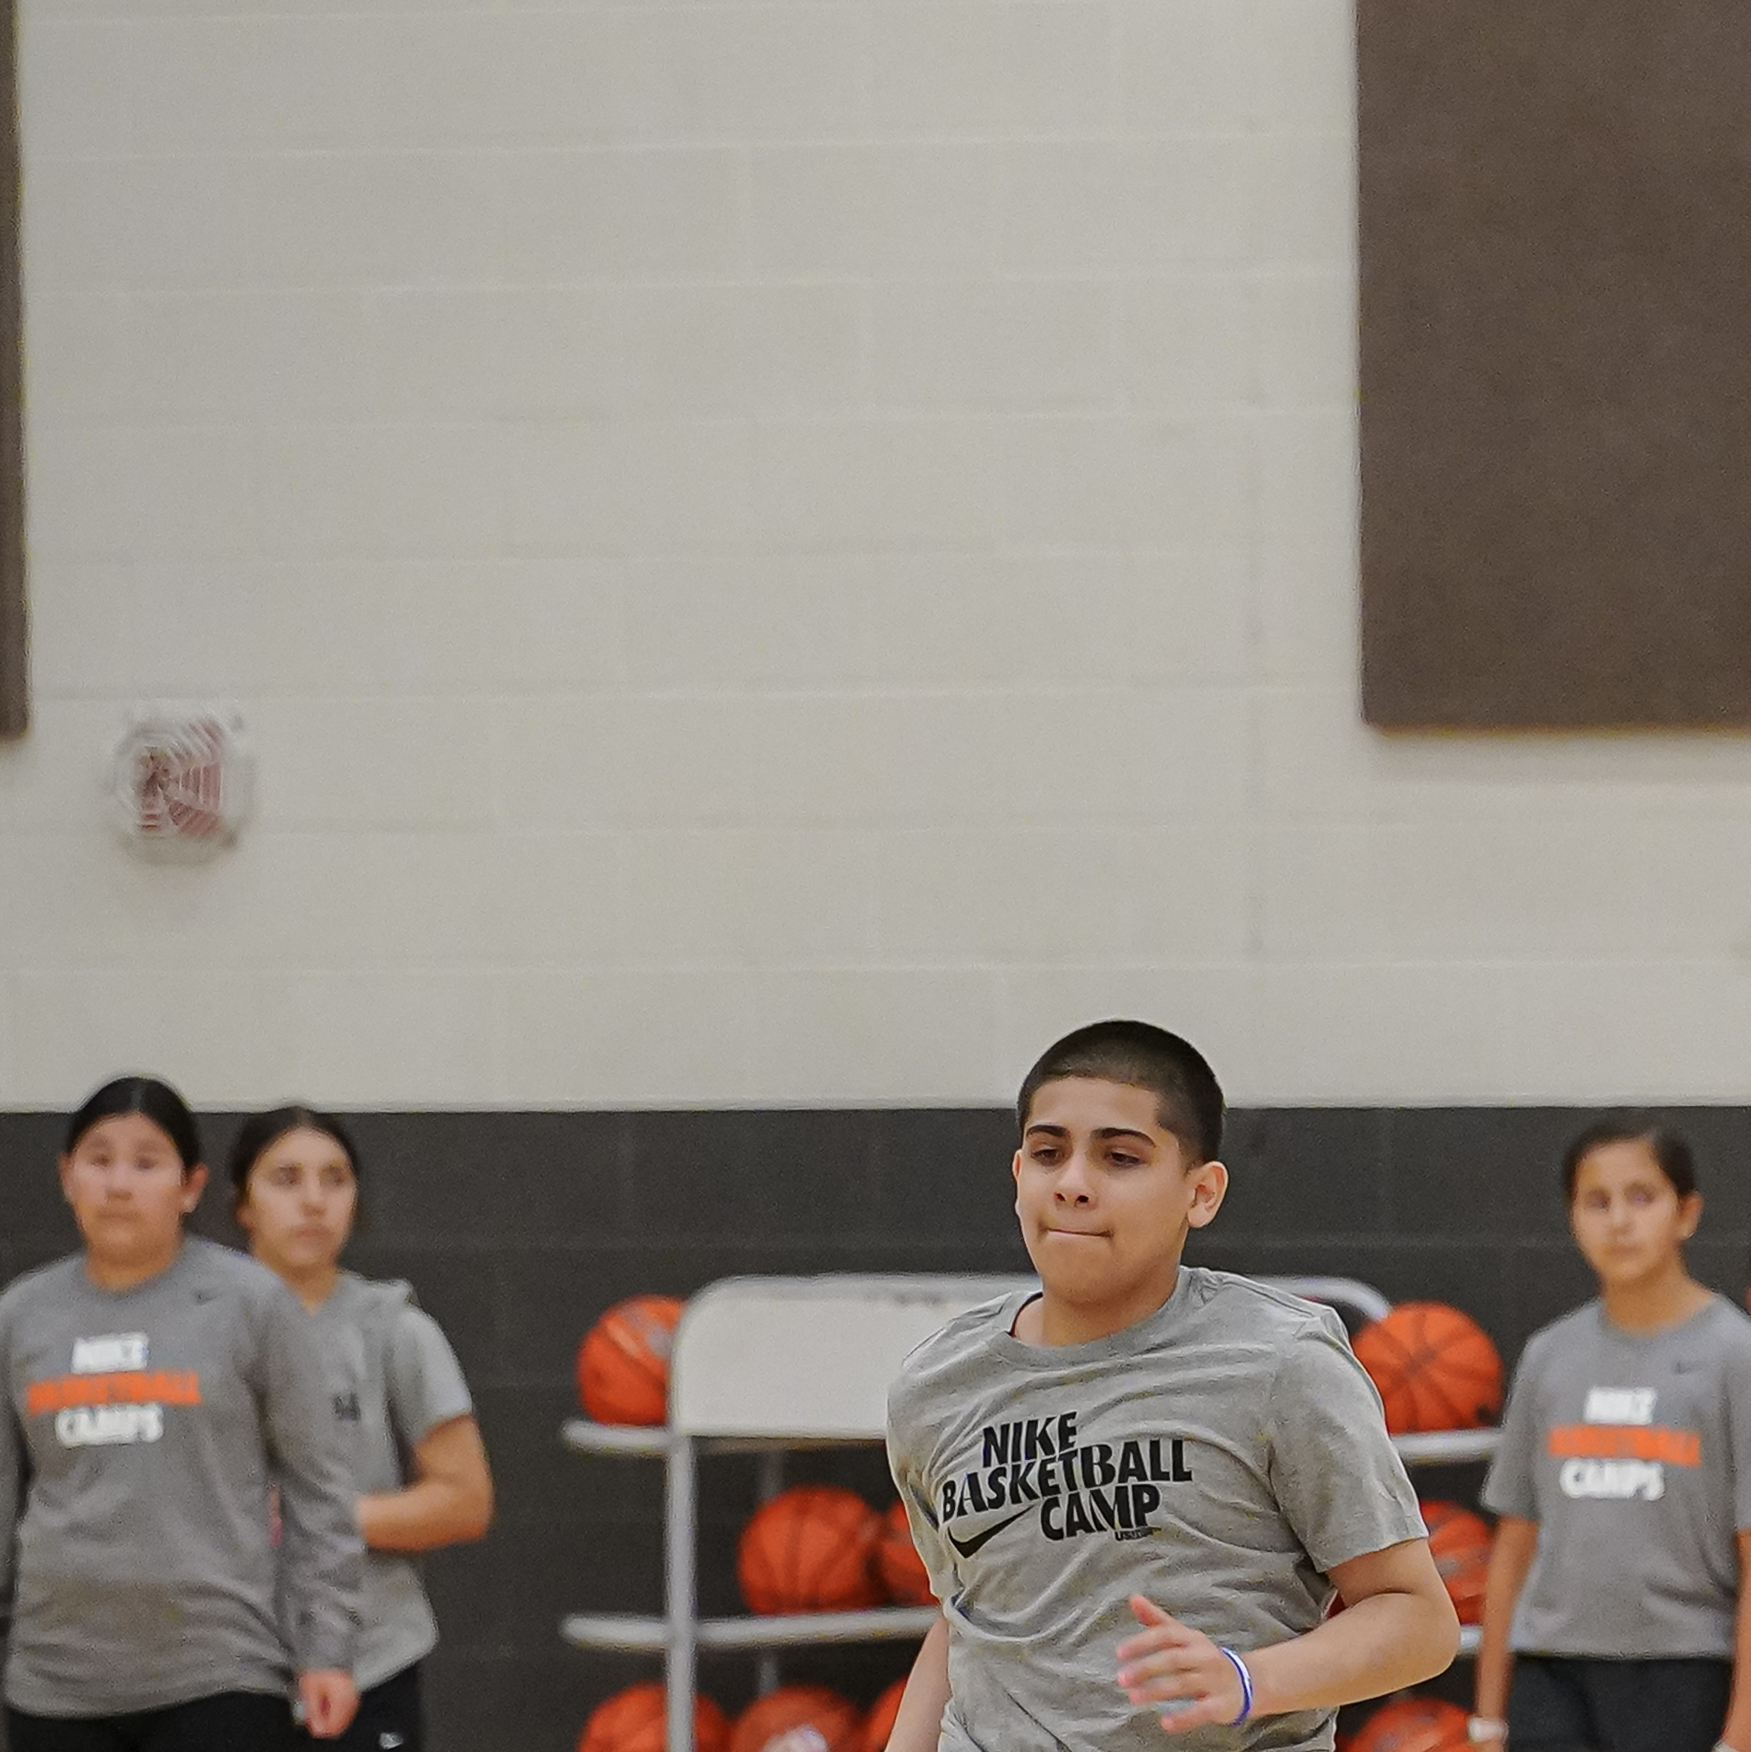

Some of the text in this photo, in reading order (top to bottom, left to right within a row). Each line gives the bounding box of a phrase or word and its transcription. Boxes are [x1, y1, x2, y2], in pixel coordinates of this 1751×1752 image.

[982, 1411, 1078, 1468] NIKE
[942, 1438, 1193, 1523] BASKETBALL
[1040, 1484, 1161, 1541] CAMP
